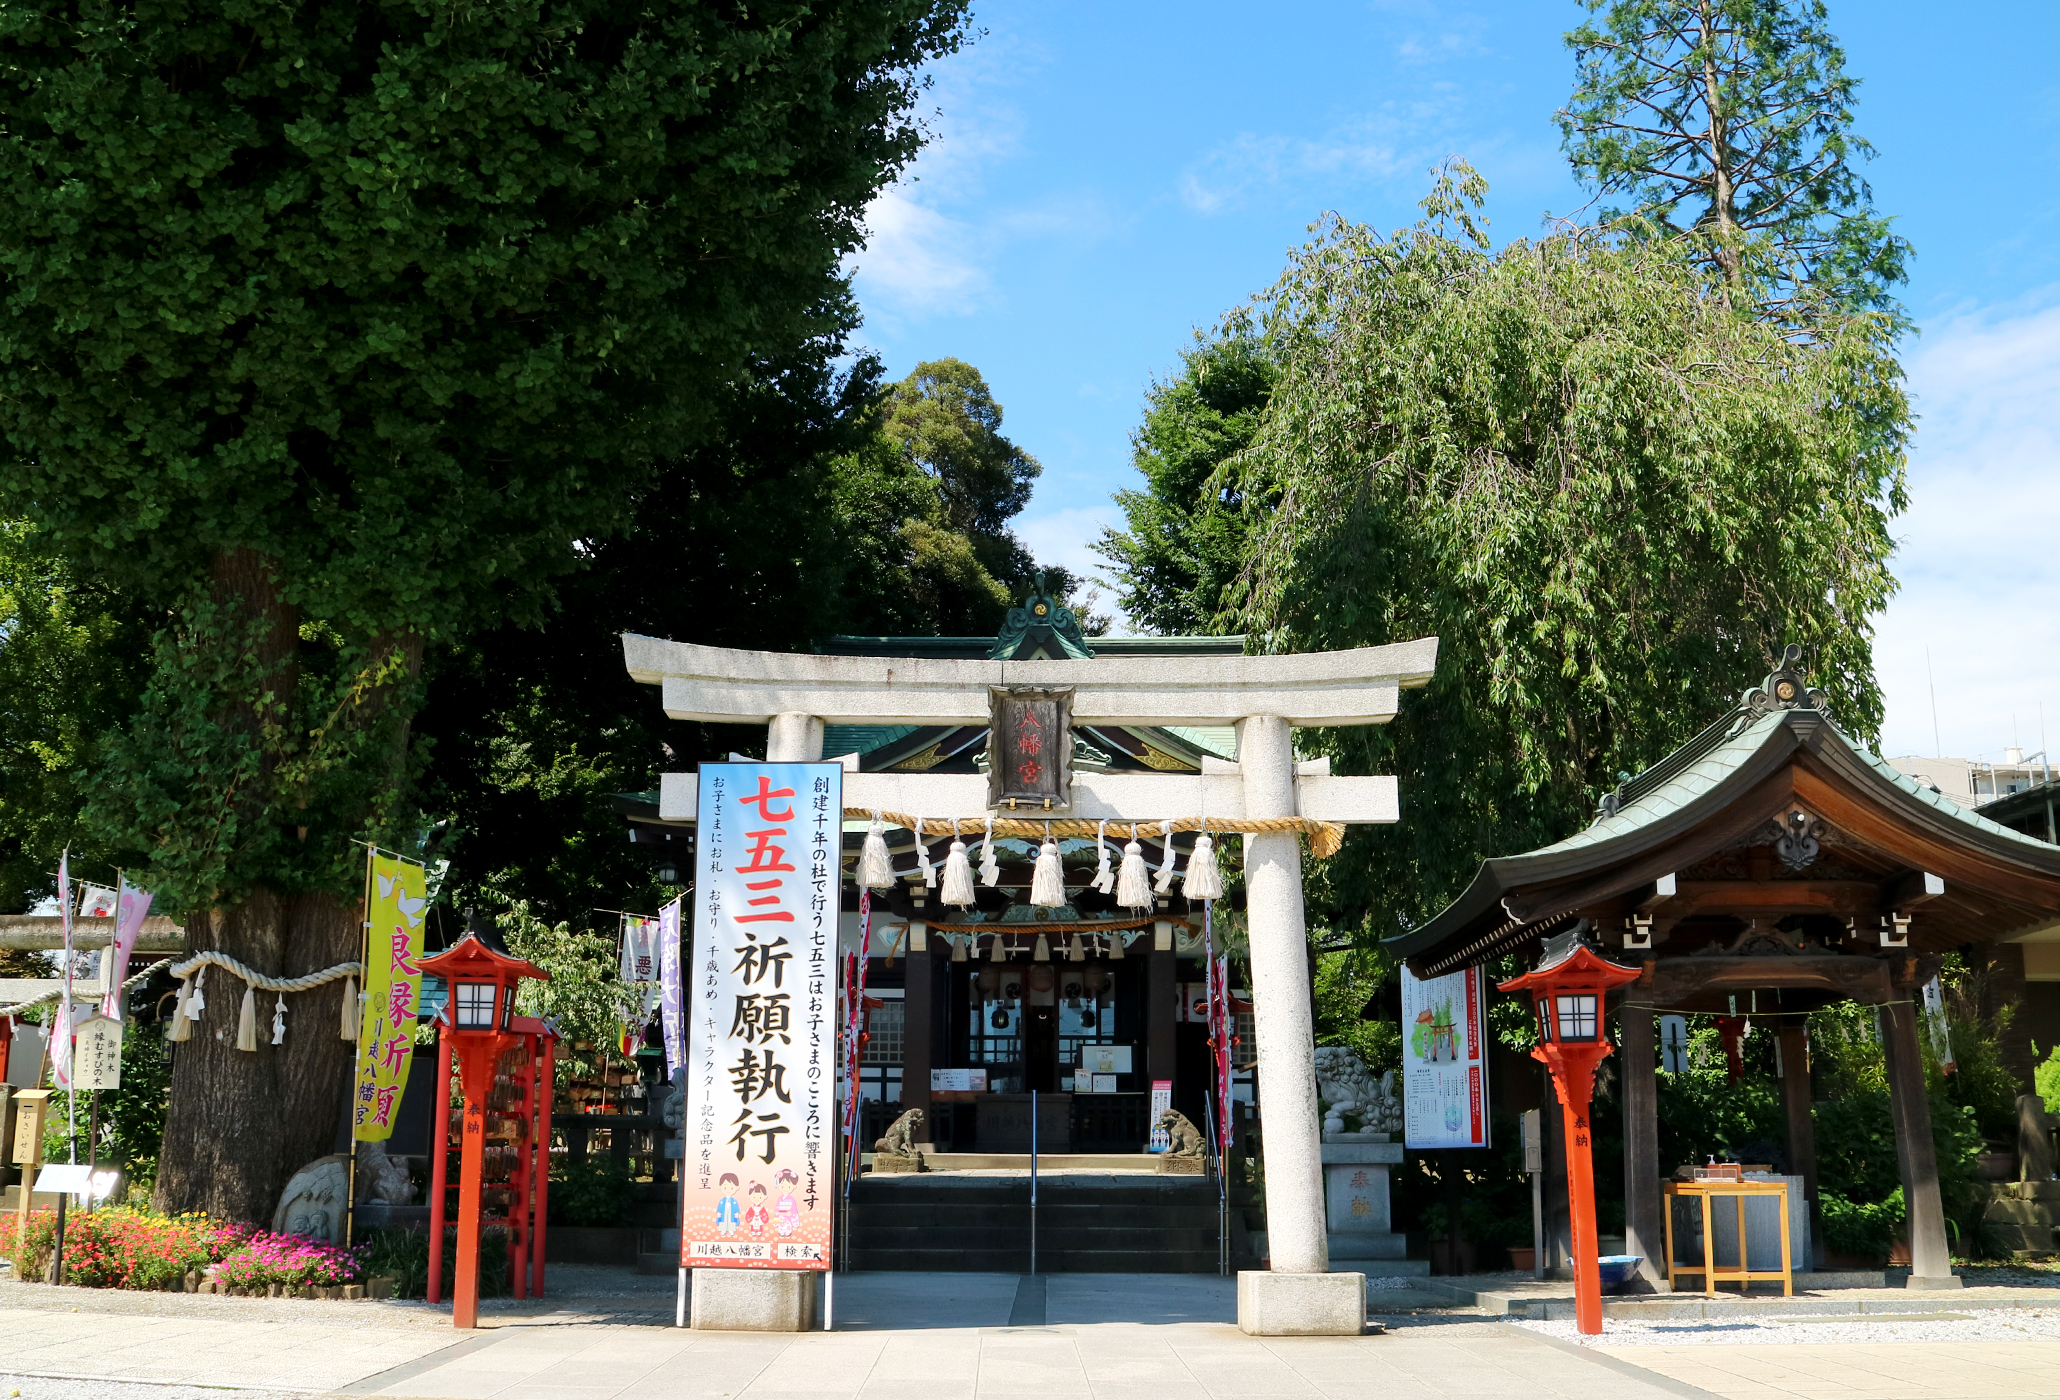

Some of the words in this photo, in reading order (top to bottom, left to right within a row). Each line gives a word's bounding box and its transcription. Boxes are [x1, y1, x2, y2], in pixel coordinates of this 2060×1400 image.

[1018, 710, 1044, 784] 八幡宮
[802, 776, 830, 1212] 創建千年の杜で行う七五三はお子さまのこころに響きます
[92, 1032, 106, 1086] 縁むすびの木
[106, 1039, 117, 1073] 御神木
[19, 1110, 31, 1160] おさいせん
[467, 1102, 481, 1134] 奉納
[1574, 1115, 1588, 1147] 奉納
[696, 1243, 765, 1257] 川越八幡宮
[784, 1245, 813, 1258] 検索
